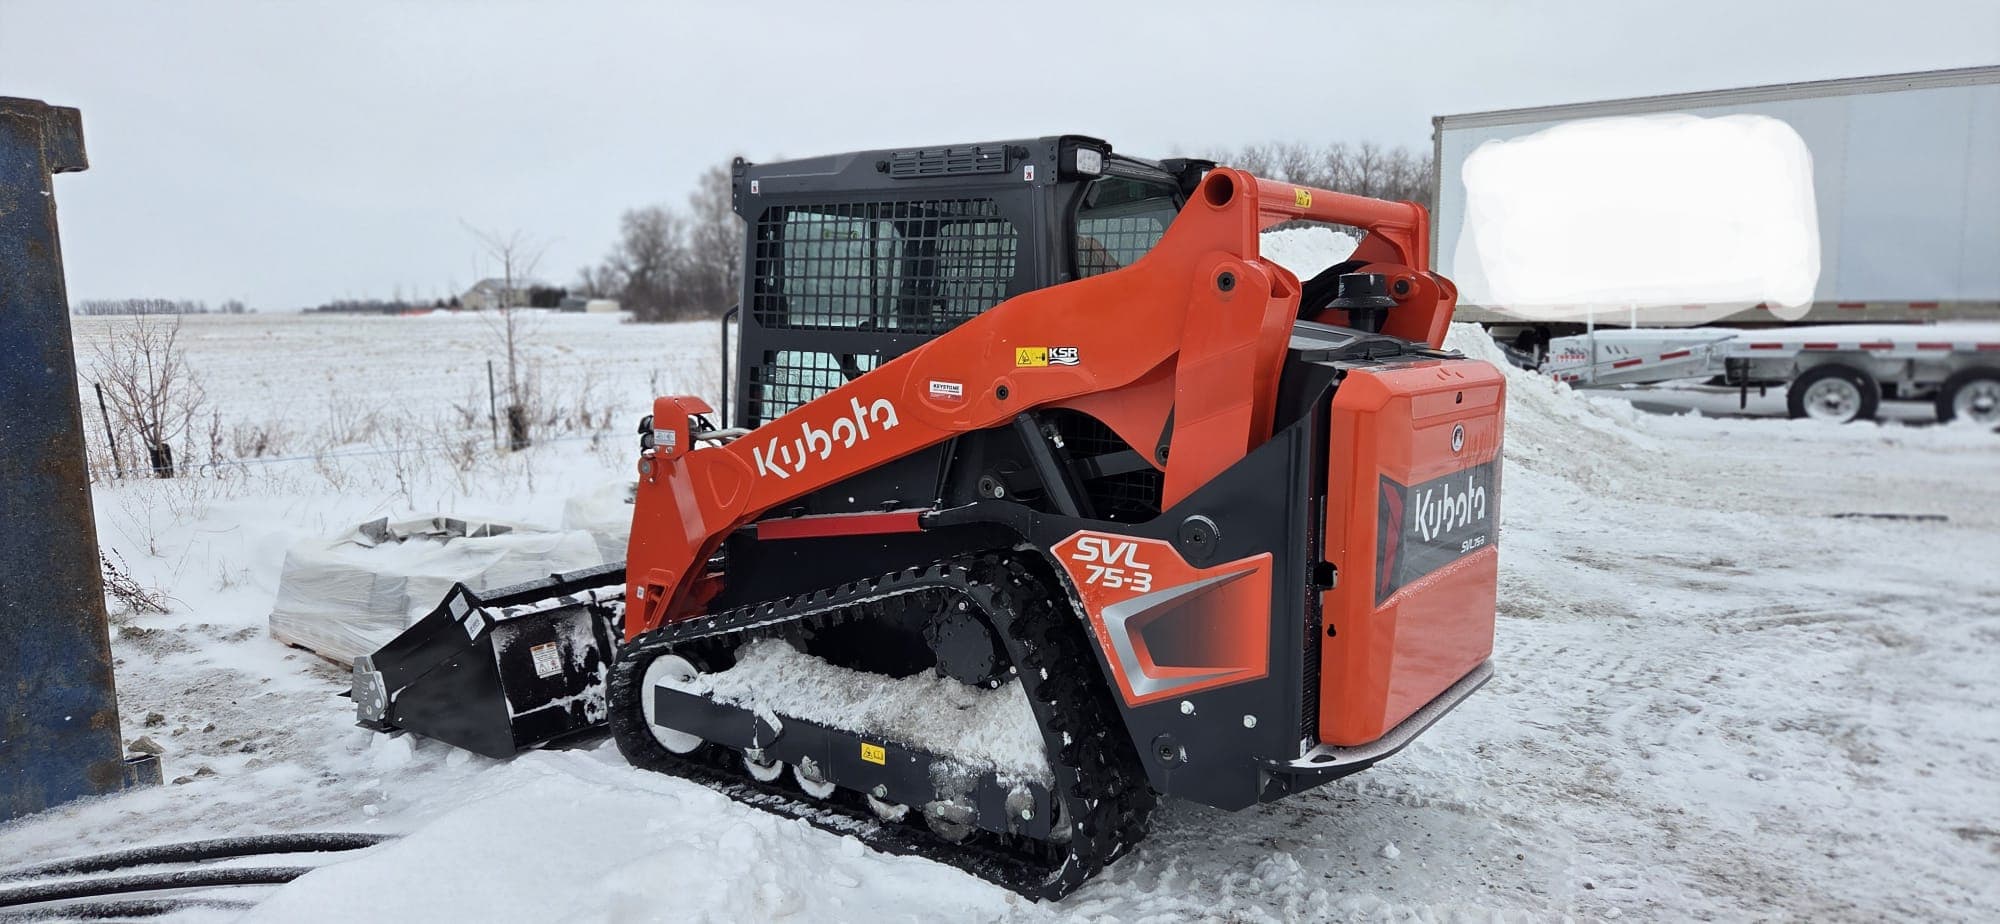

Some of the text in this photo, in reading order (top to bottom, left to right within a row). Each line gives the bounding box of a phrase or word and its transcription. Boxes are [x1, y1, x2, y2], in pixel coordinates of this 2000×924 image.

[1049, 347, 1078, 358] KSR
[753, 396, 899, 480] Kubota
[1415, 475, 1486, 542] Kubota
[1072, 536, 1151, 570] SVL
[1085, 564, 1152, 593] 75-3
